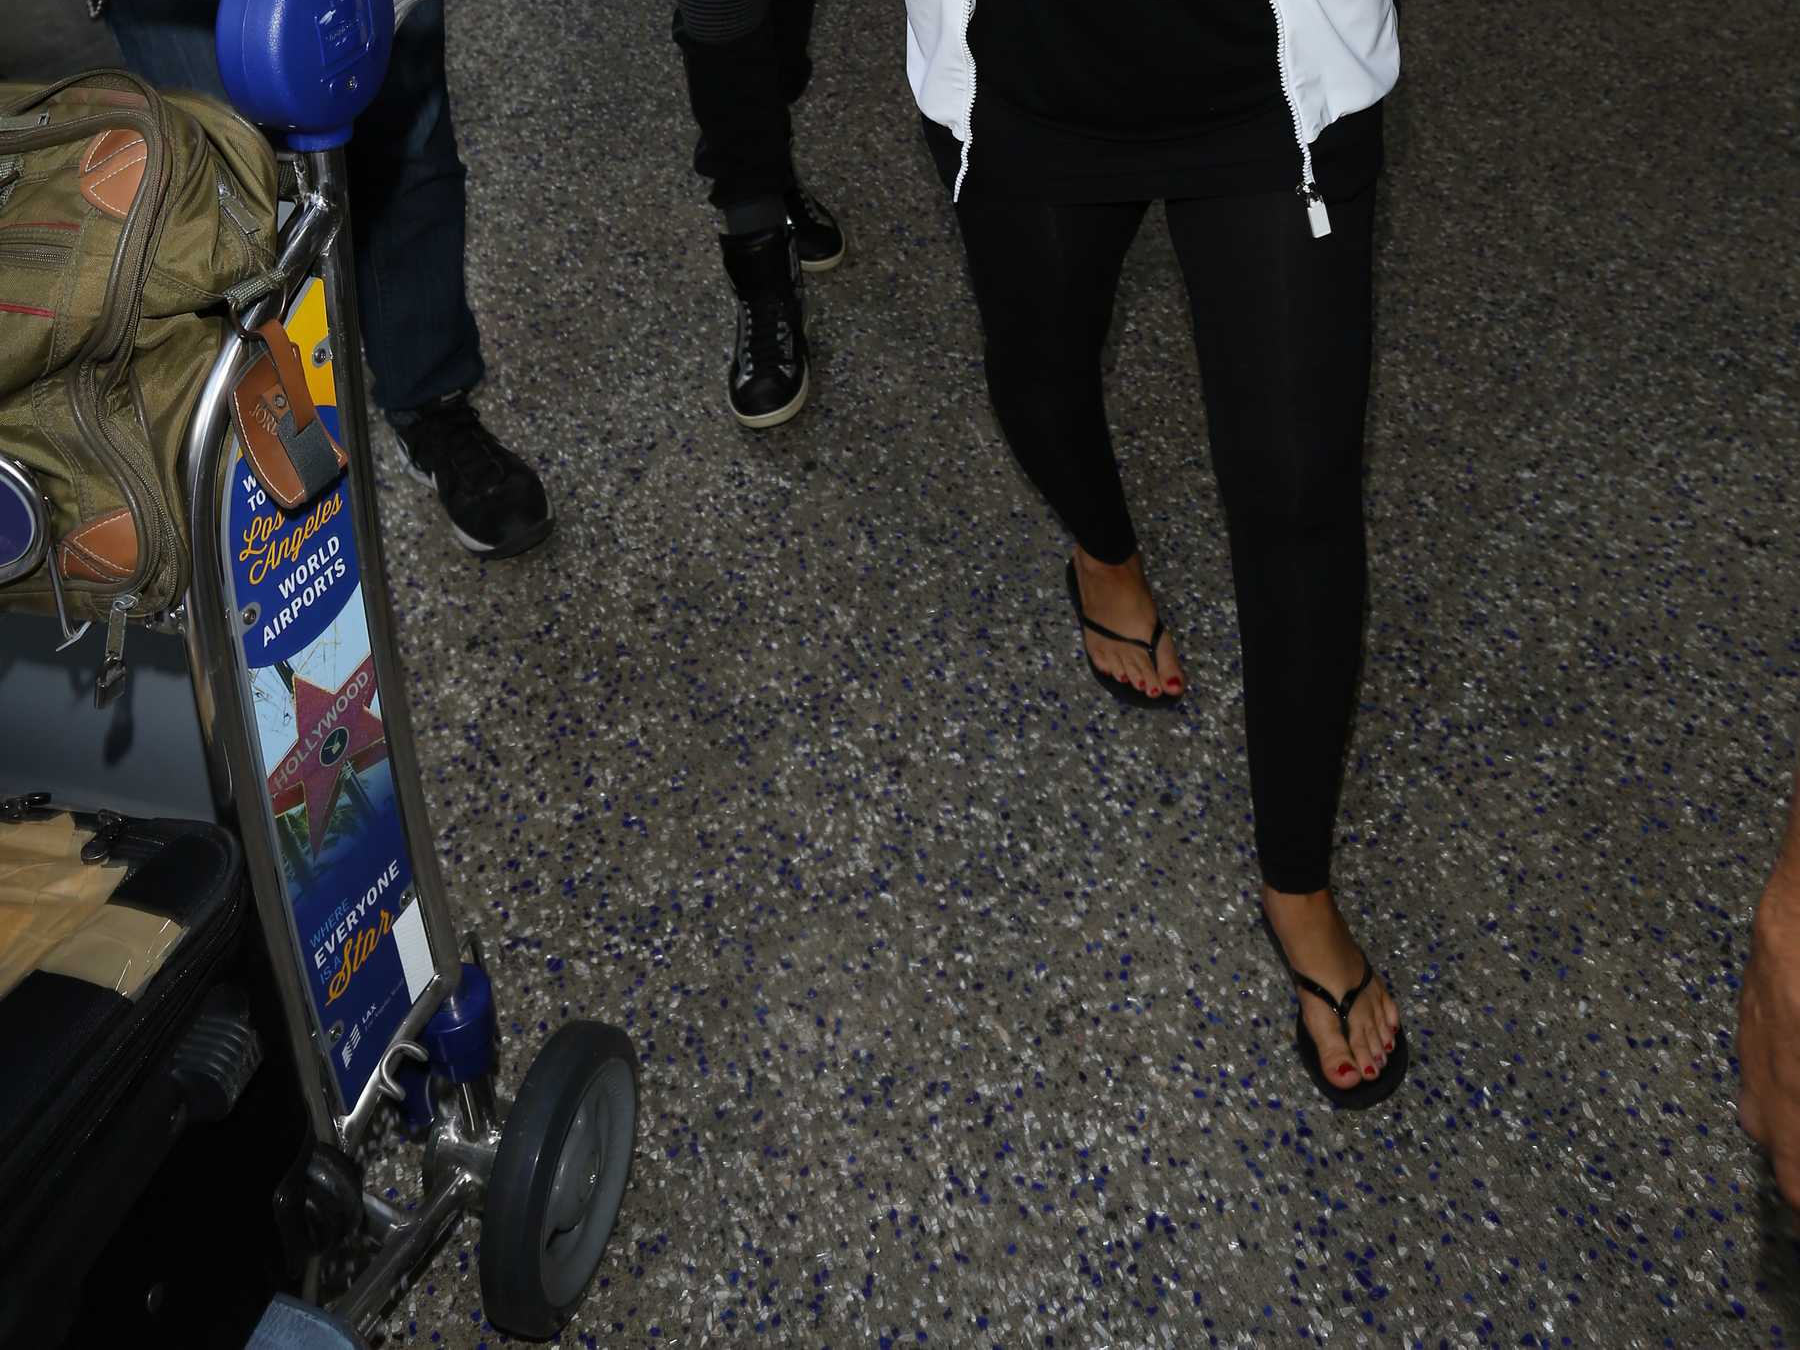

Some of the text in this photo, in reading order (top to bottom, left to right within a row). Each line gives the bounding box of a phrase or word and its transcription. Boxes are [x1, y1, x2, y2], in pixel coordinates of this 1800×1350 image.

[239, 510, 286, 562] Los
[247, 489, 266, 511] TO
[249, 493, 343, 585] Angeles
[278, 536, 340, 600] WORLD
[262, 558, 346, 648] AIRPORTS
[273, 671, 369, 790] HOLLYWOOD
[309, 897, 351, 949] WHERE
[313, 859, 400, 970] EVERYONE
[319, 908, 395, 1008] IS A Star
[362, 1002, 377, 1025] LAX
